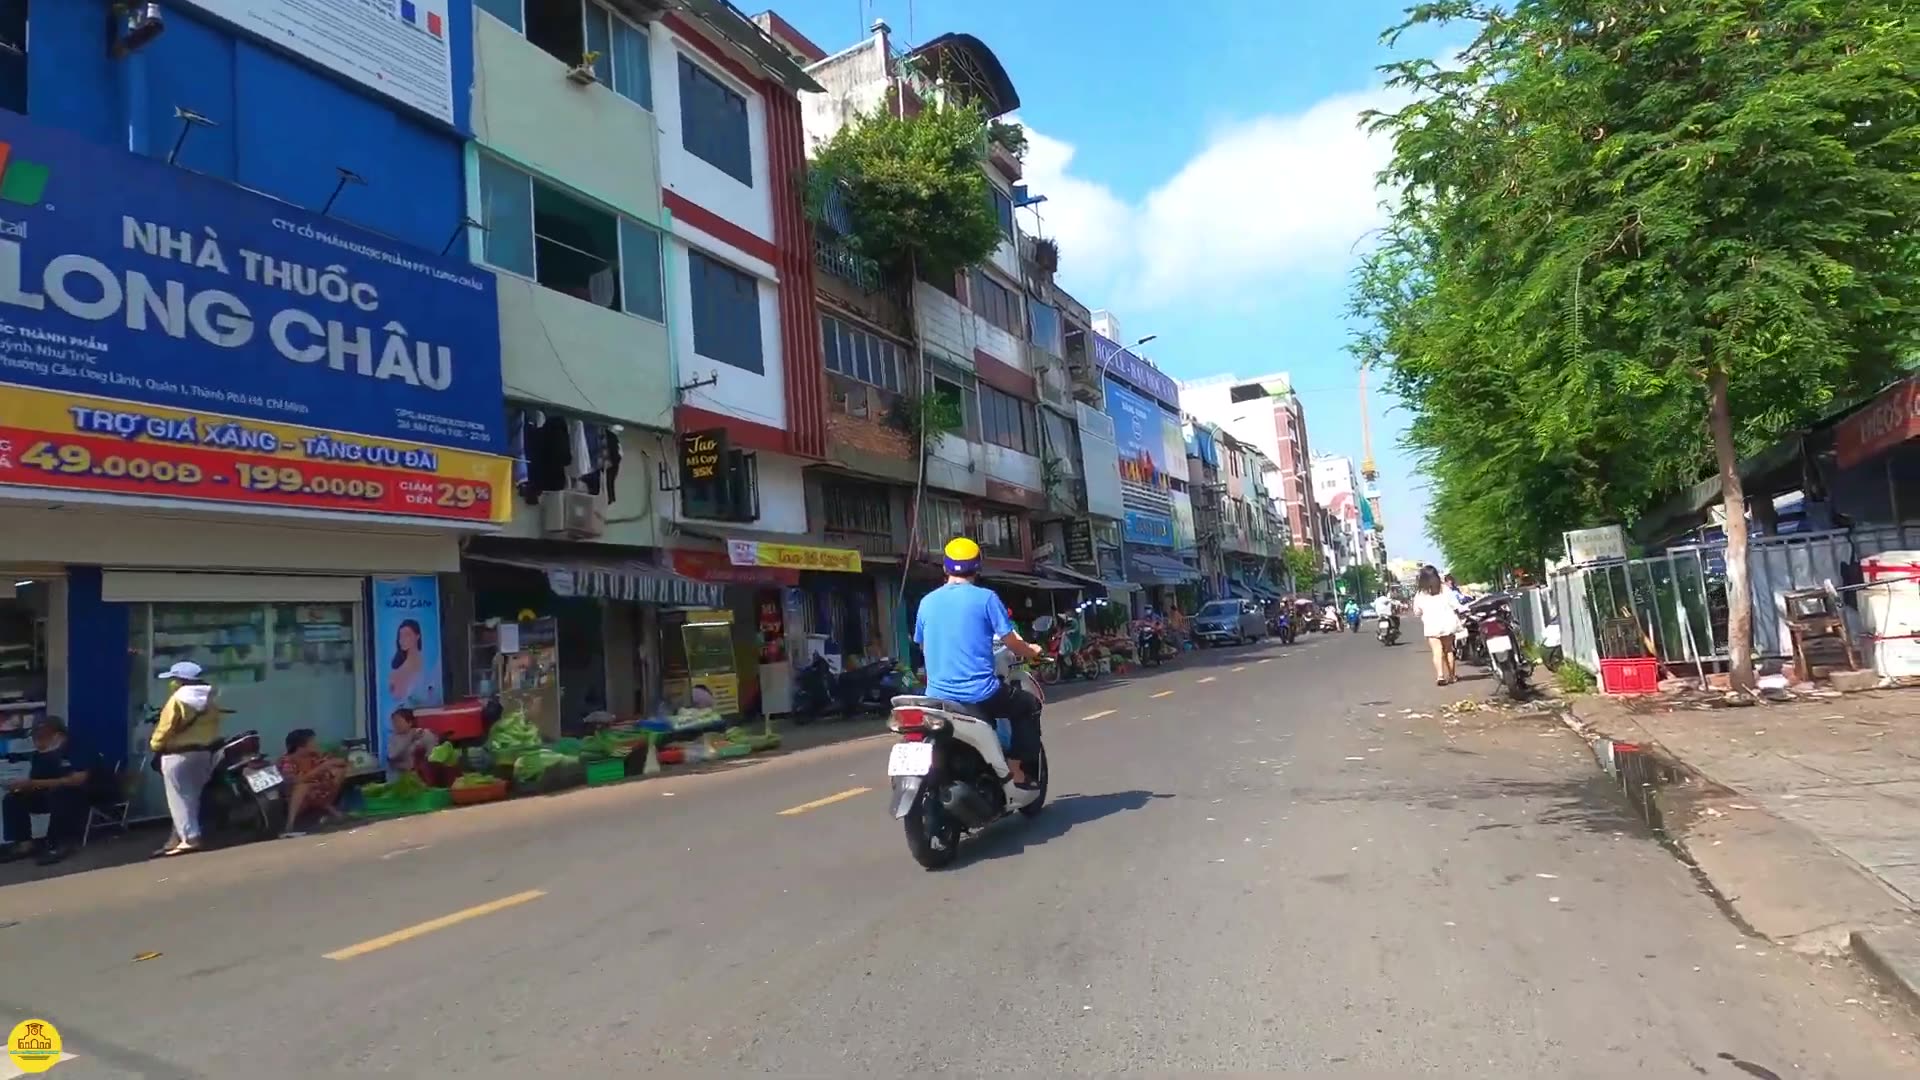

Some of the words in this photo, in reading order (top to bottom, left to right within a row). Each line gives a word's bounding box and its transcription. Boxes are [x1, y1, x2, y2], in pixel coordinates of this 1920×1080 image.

[123, 215, 230, 275] NHÀ
[239, 249, 379, 311] THUỐC
[0, 238, 255, 348] LONG
[269, 308, 453, 391] CHÂU
[20, 441, 204, 483] 49.000Đ
[235, 462, 385, 499] 199.000Đ
[70, 406, 142, 438] TRỢ
[146, 415, 197, 441] GIÁ
[204, 422, 277, 451] XĂNG
[302, 435, 362, 460] TĂNG
[366, 447, 399, 466] ƯU
